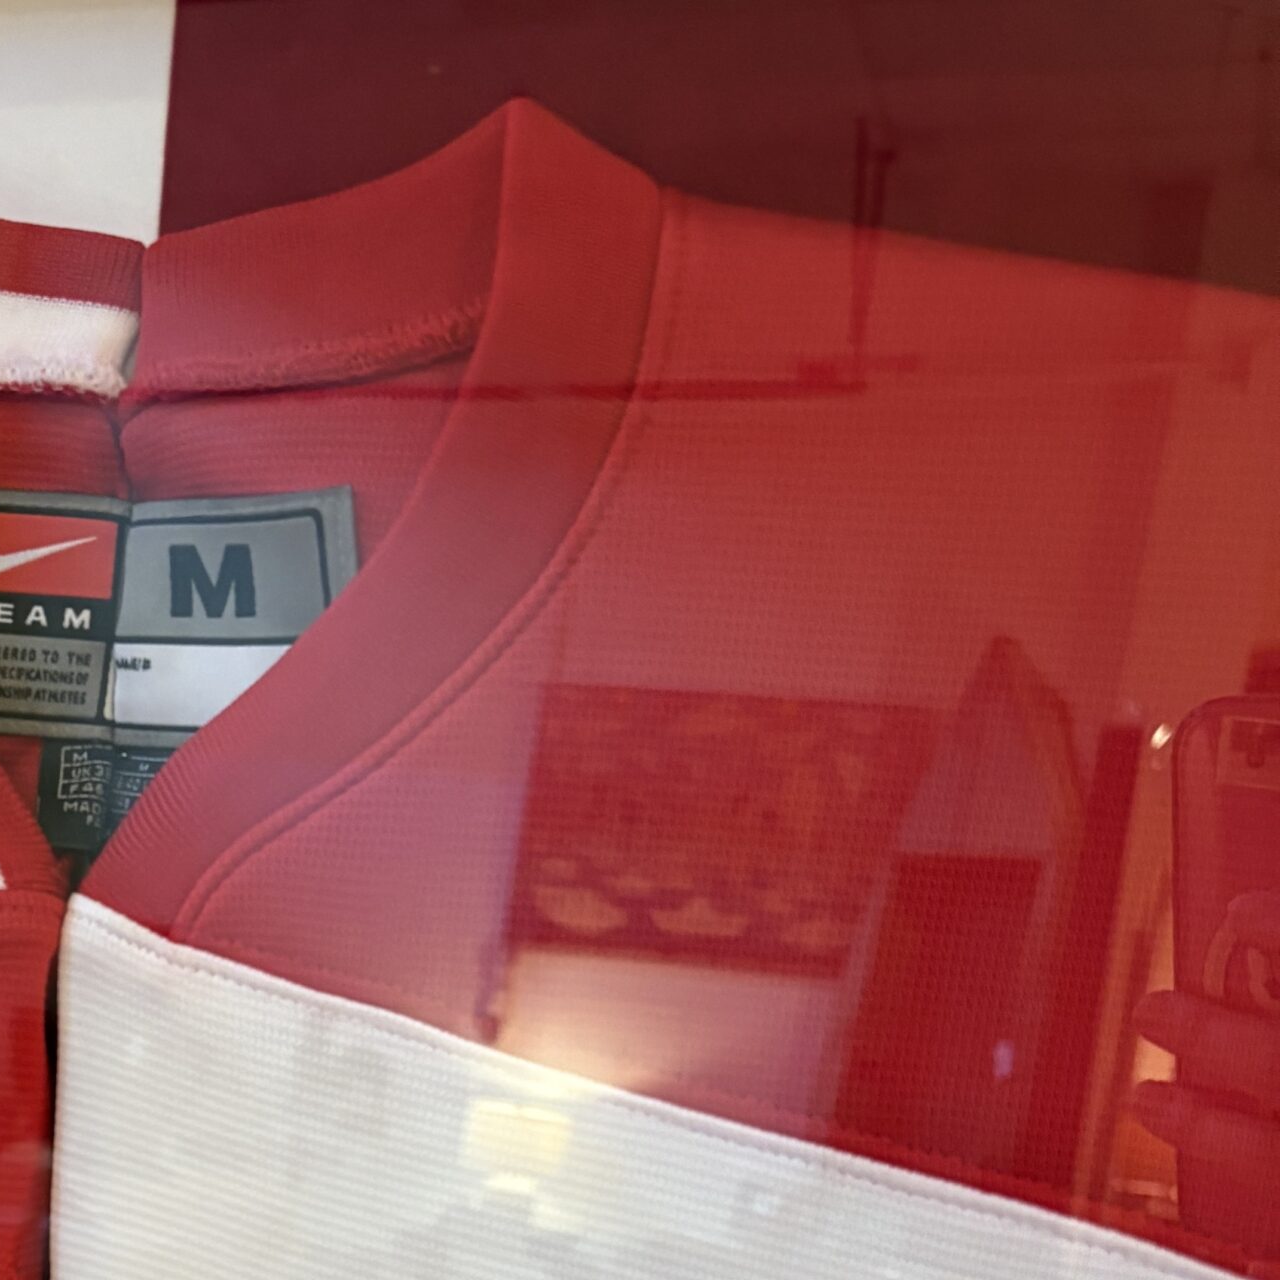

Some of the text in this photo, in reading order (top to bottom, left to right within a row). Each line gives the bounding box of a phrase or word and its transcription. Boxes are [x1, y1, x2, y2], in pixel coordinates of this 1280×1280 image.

[168, 543, 257, 619] M
[42, 649, 60, 665] TO
[68, 651, 93, 667] THE
